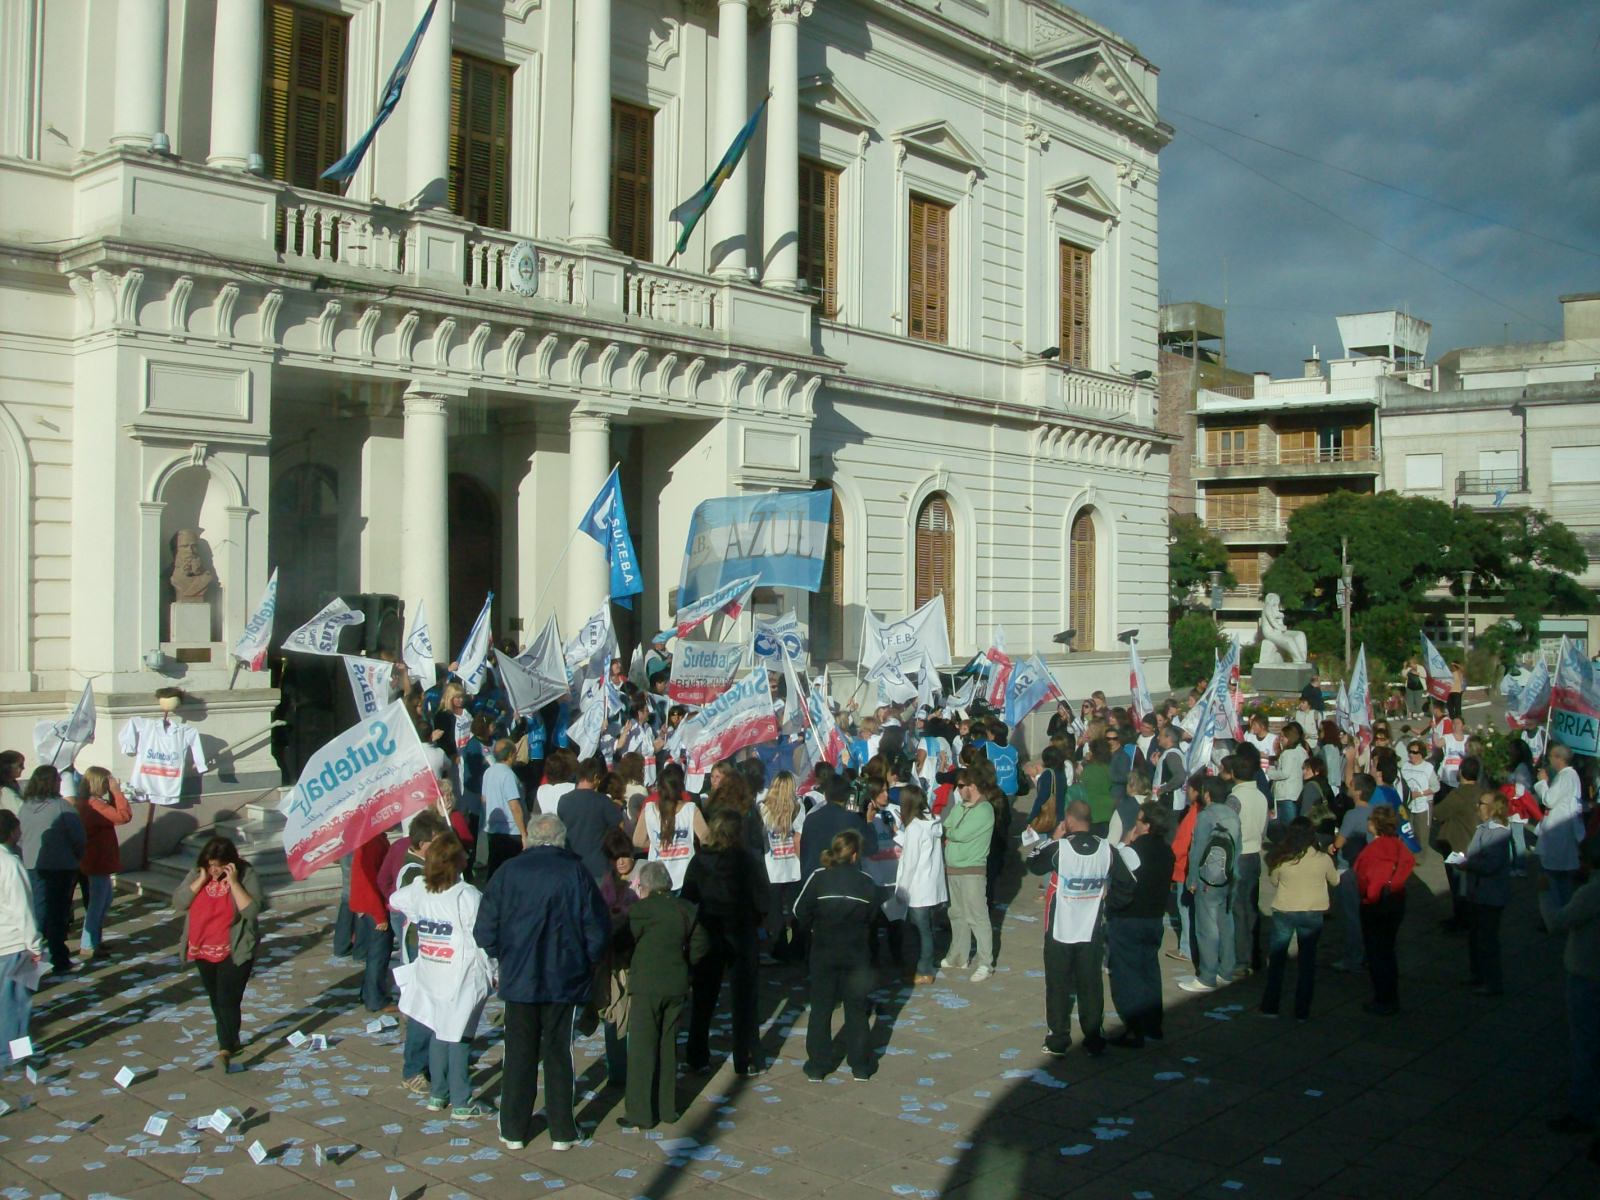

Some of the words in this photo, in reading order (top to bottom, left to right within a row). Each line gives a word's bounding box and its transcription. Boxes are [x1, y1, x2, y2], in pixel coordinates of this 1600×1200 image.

[724, 510, 814, 561] AZUL
[887, 633, 915, 645] F.E.B.
[683, 645, 726, 669] Suteba
